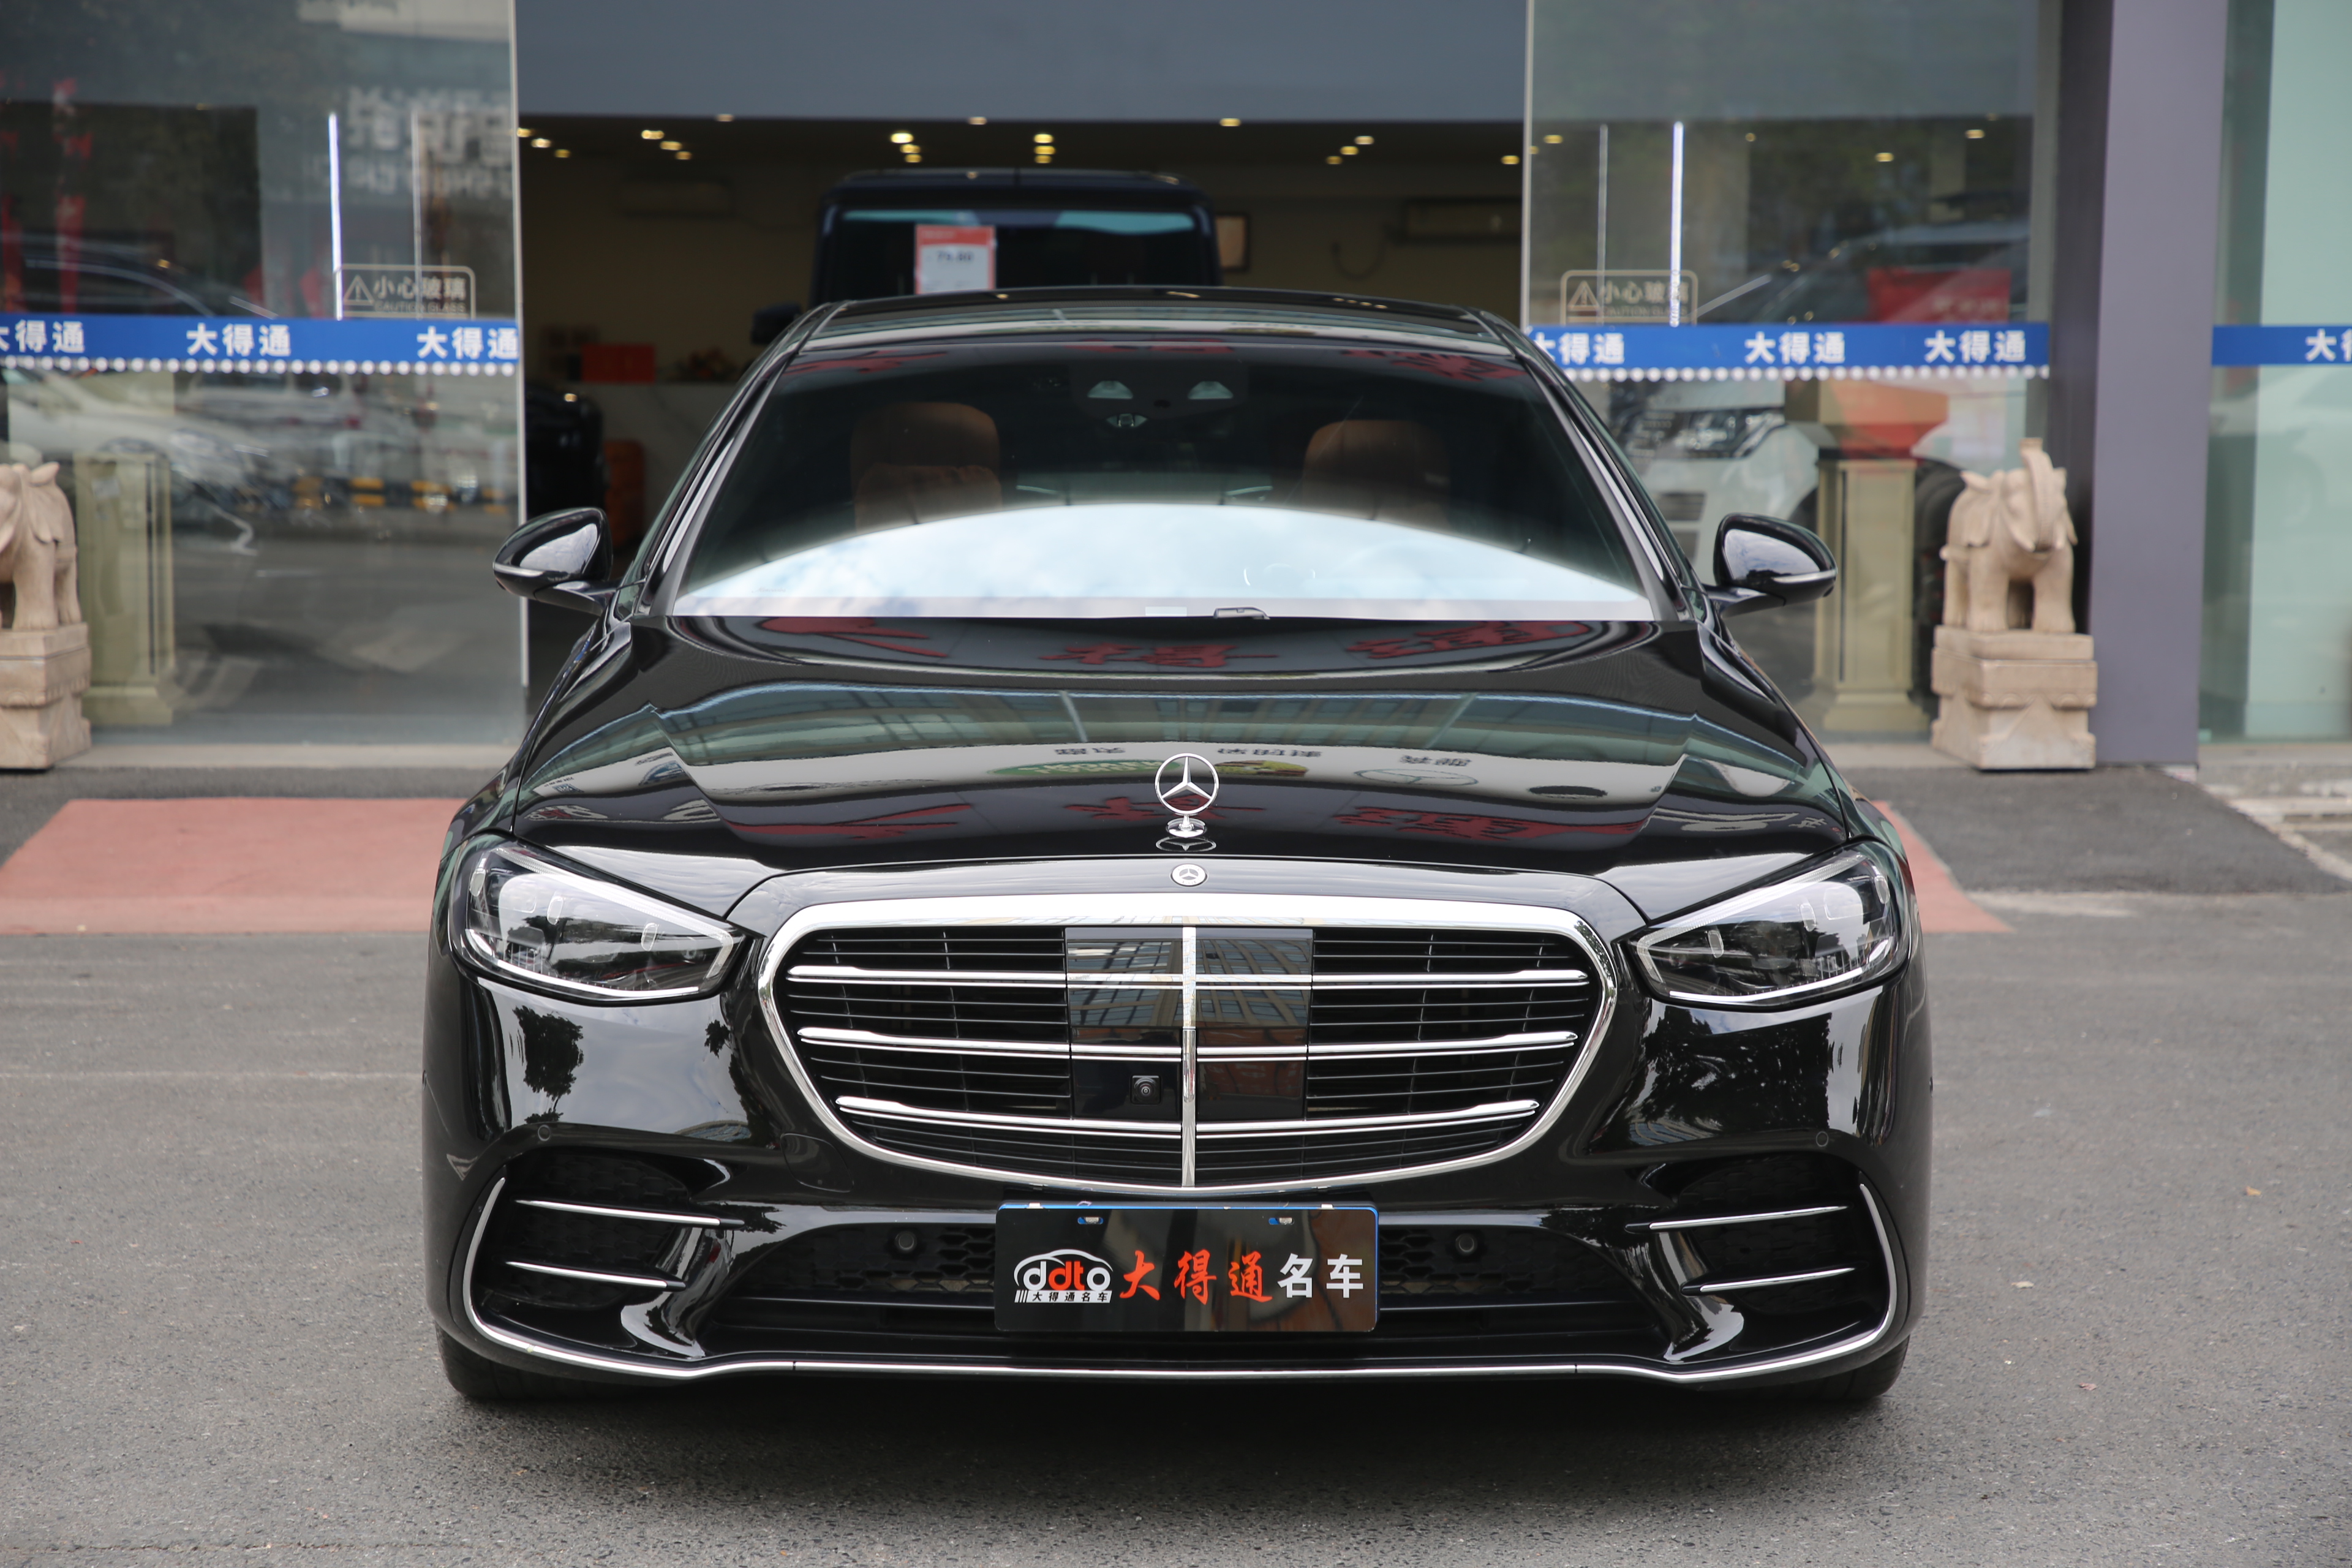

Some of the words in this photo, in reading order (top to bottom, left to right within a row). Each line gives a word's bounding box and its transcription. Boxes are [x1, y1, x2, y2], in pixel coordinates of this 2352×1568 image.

[186, 322, 291, 357] 大得通
[417, 325, 519, 360] 大得通
[1744, 331, 1845, 364] 大得通
[1924, 330, 2026, 363] 大得通
[1023, 1261, 1110, 1291] ddto
[1119, 1249, 1363, 1305] 大得通名车
[1031, 1292, 1109, 1302] 大得通名车
